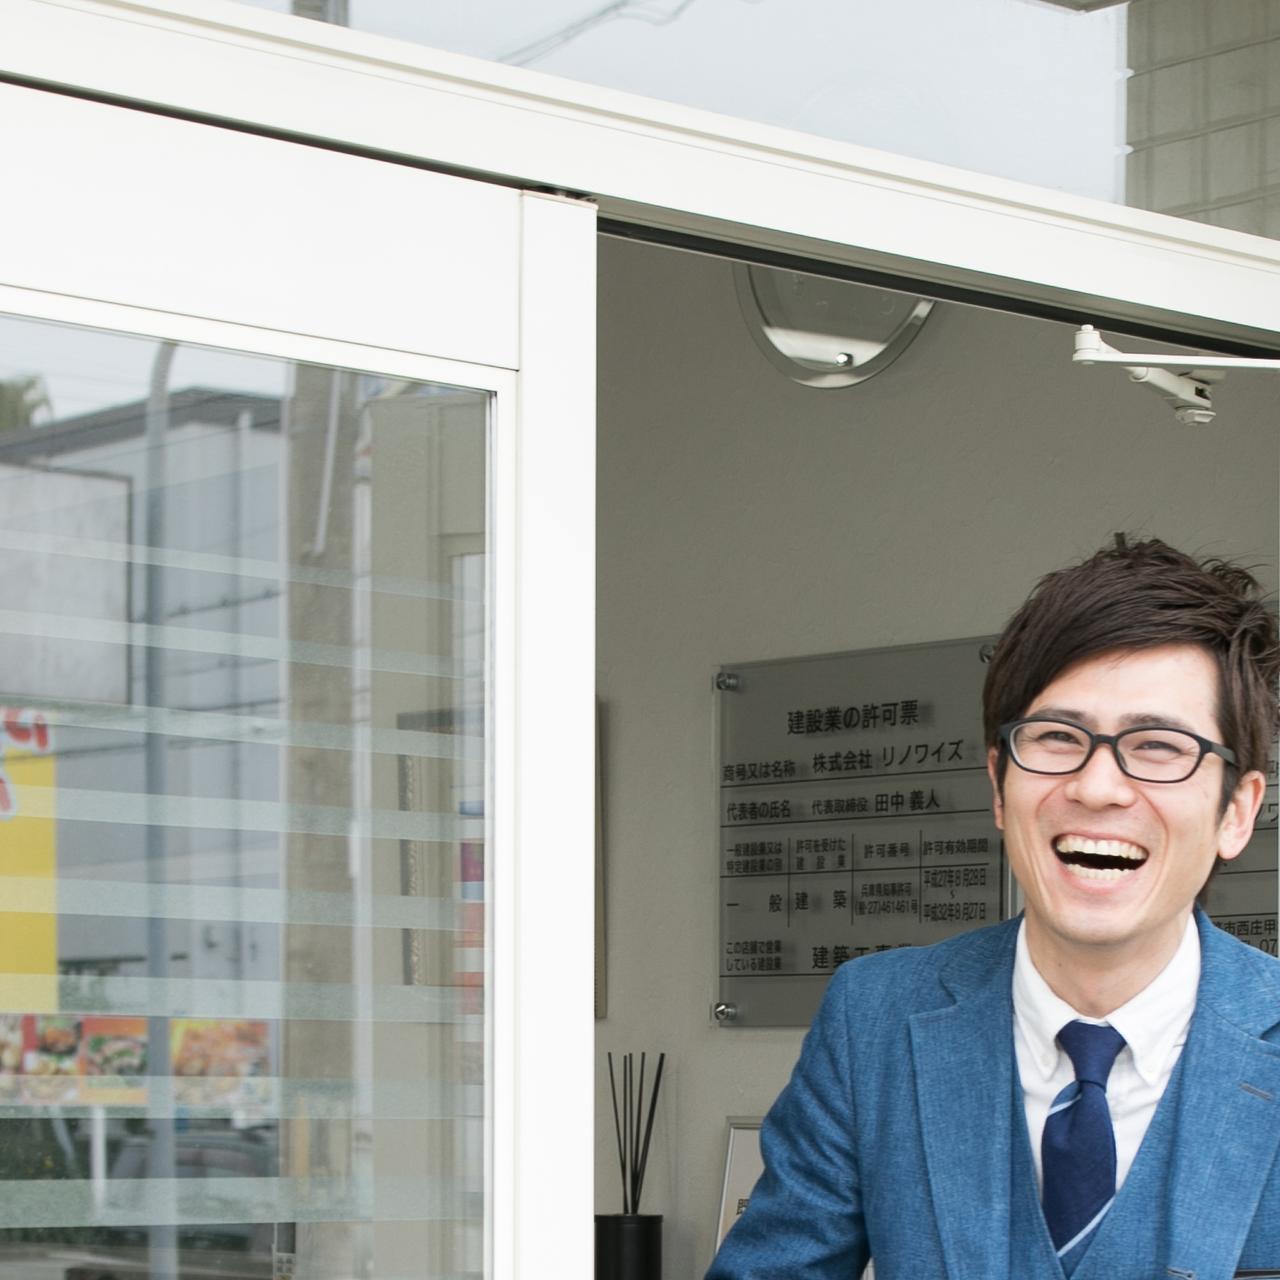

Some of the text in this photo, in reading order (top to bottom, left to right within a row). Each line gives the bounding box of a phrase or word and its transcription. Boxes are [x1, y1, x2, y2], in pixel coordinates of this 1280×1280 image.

[787, 699, 919, 736] 建設業の許可票
[722, 739, 964, 782] 商号又は名称 株式会社 リノワイズ
[726, 800, 791, 820] 代表者の氏名
[811, 797, 868, 815] 代表取締役
[796, 838, 846, 853] 許可を受けた
[863, 842, 910, 859] 許可番号
[923, 838, 988, 856] 許可有効期間
